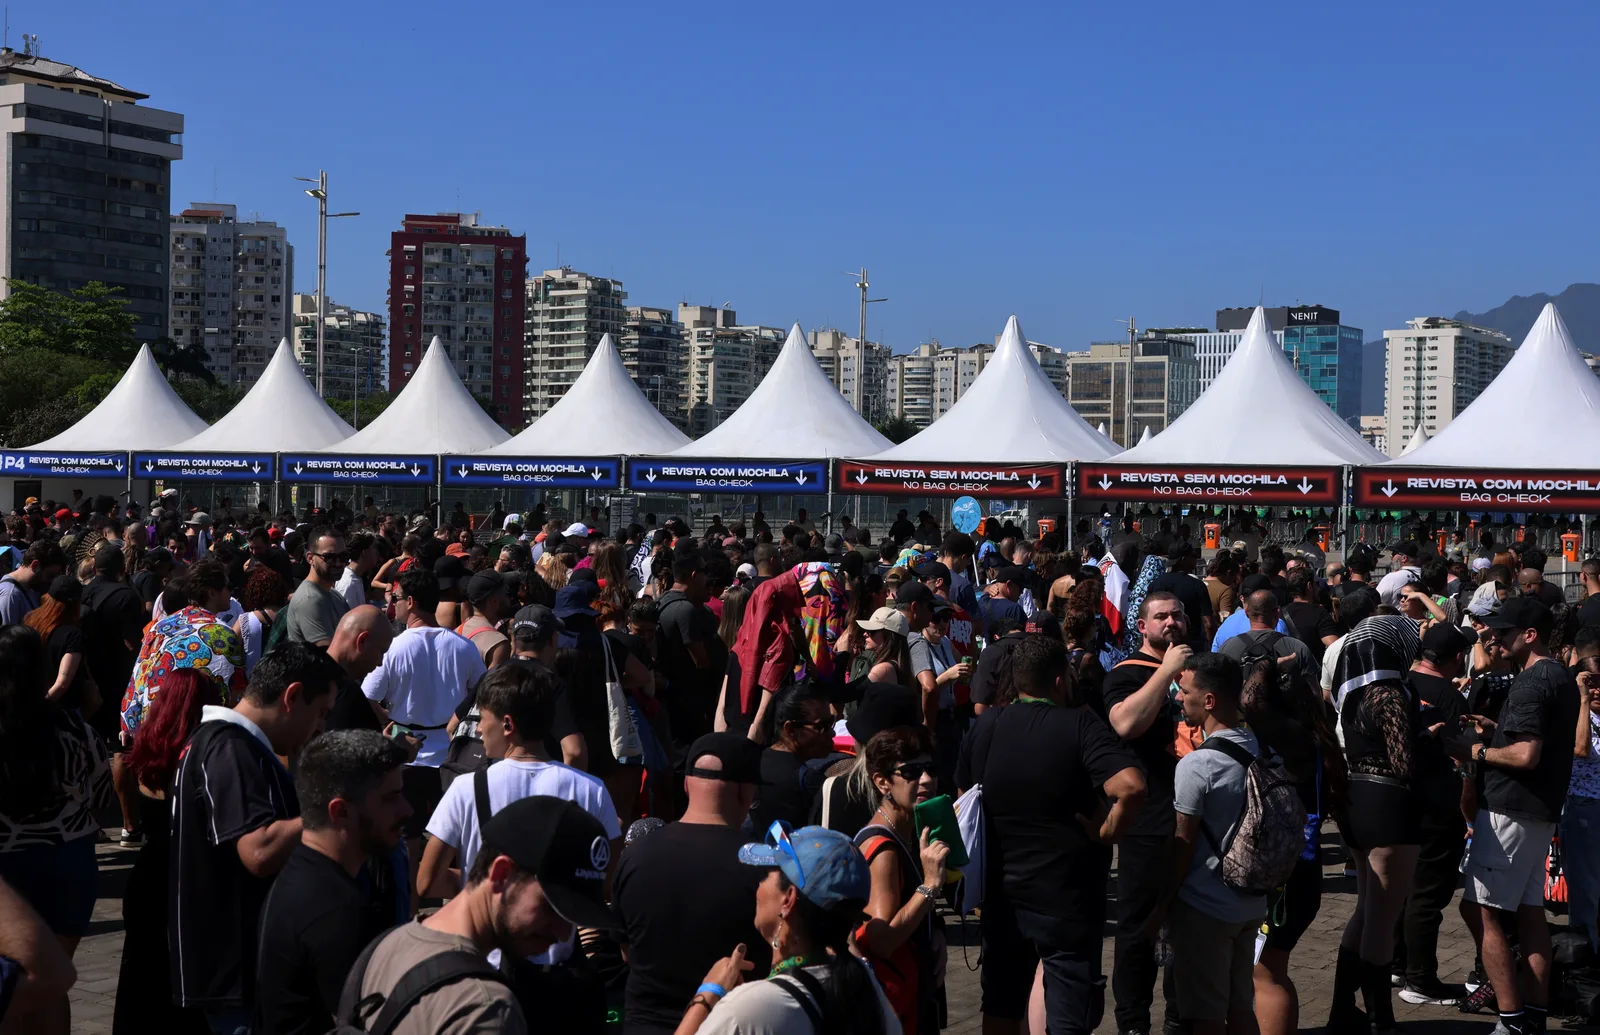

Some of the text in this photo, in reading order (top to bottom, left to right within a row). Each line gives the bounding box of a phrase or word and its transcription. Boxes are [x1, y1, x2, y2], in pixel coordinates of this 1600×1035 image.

[1291, 312, 1318, 320] VENIT
[5, 456, 25, 469] P4
[344, 461, 364, 469] COM
[473, 463, 585, 473] REVISTA COM MOCHILA
[662, 467, 788, 477] REVISTA COM MOCHILA
[503, 474, 521, 482] BAG
[875, 469, 1019, 481] REVISTA SEM MOCHILA
[1120, 473, 1287, 485] REVISTA SEM MOCHILA
[719, 479, 753, 487] CHECK
[904, 481, 988, 491] NO BAG CHECK
[1407, 478, 1476, 489] REVISTA
[1482, 479, 1523, 490] COM
[1153, 486, 1252, 496] NO BAG CHECK
[1461, 493, 1550, 503] BAG CHECK
